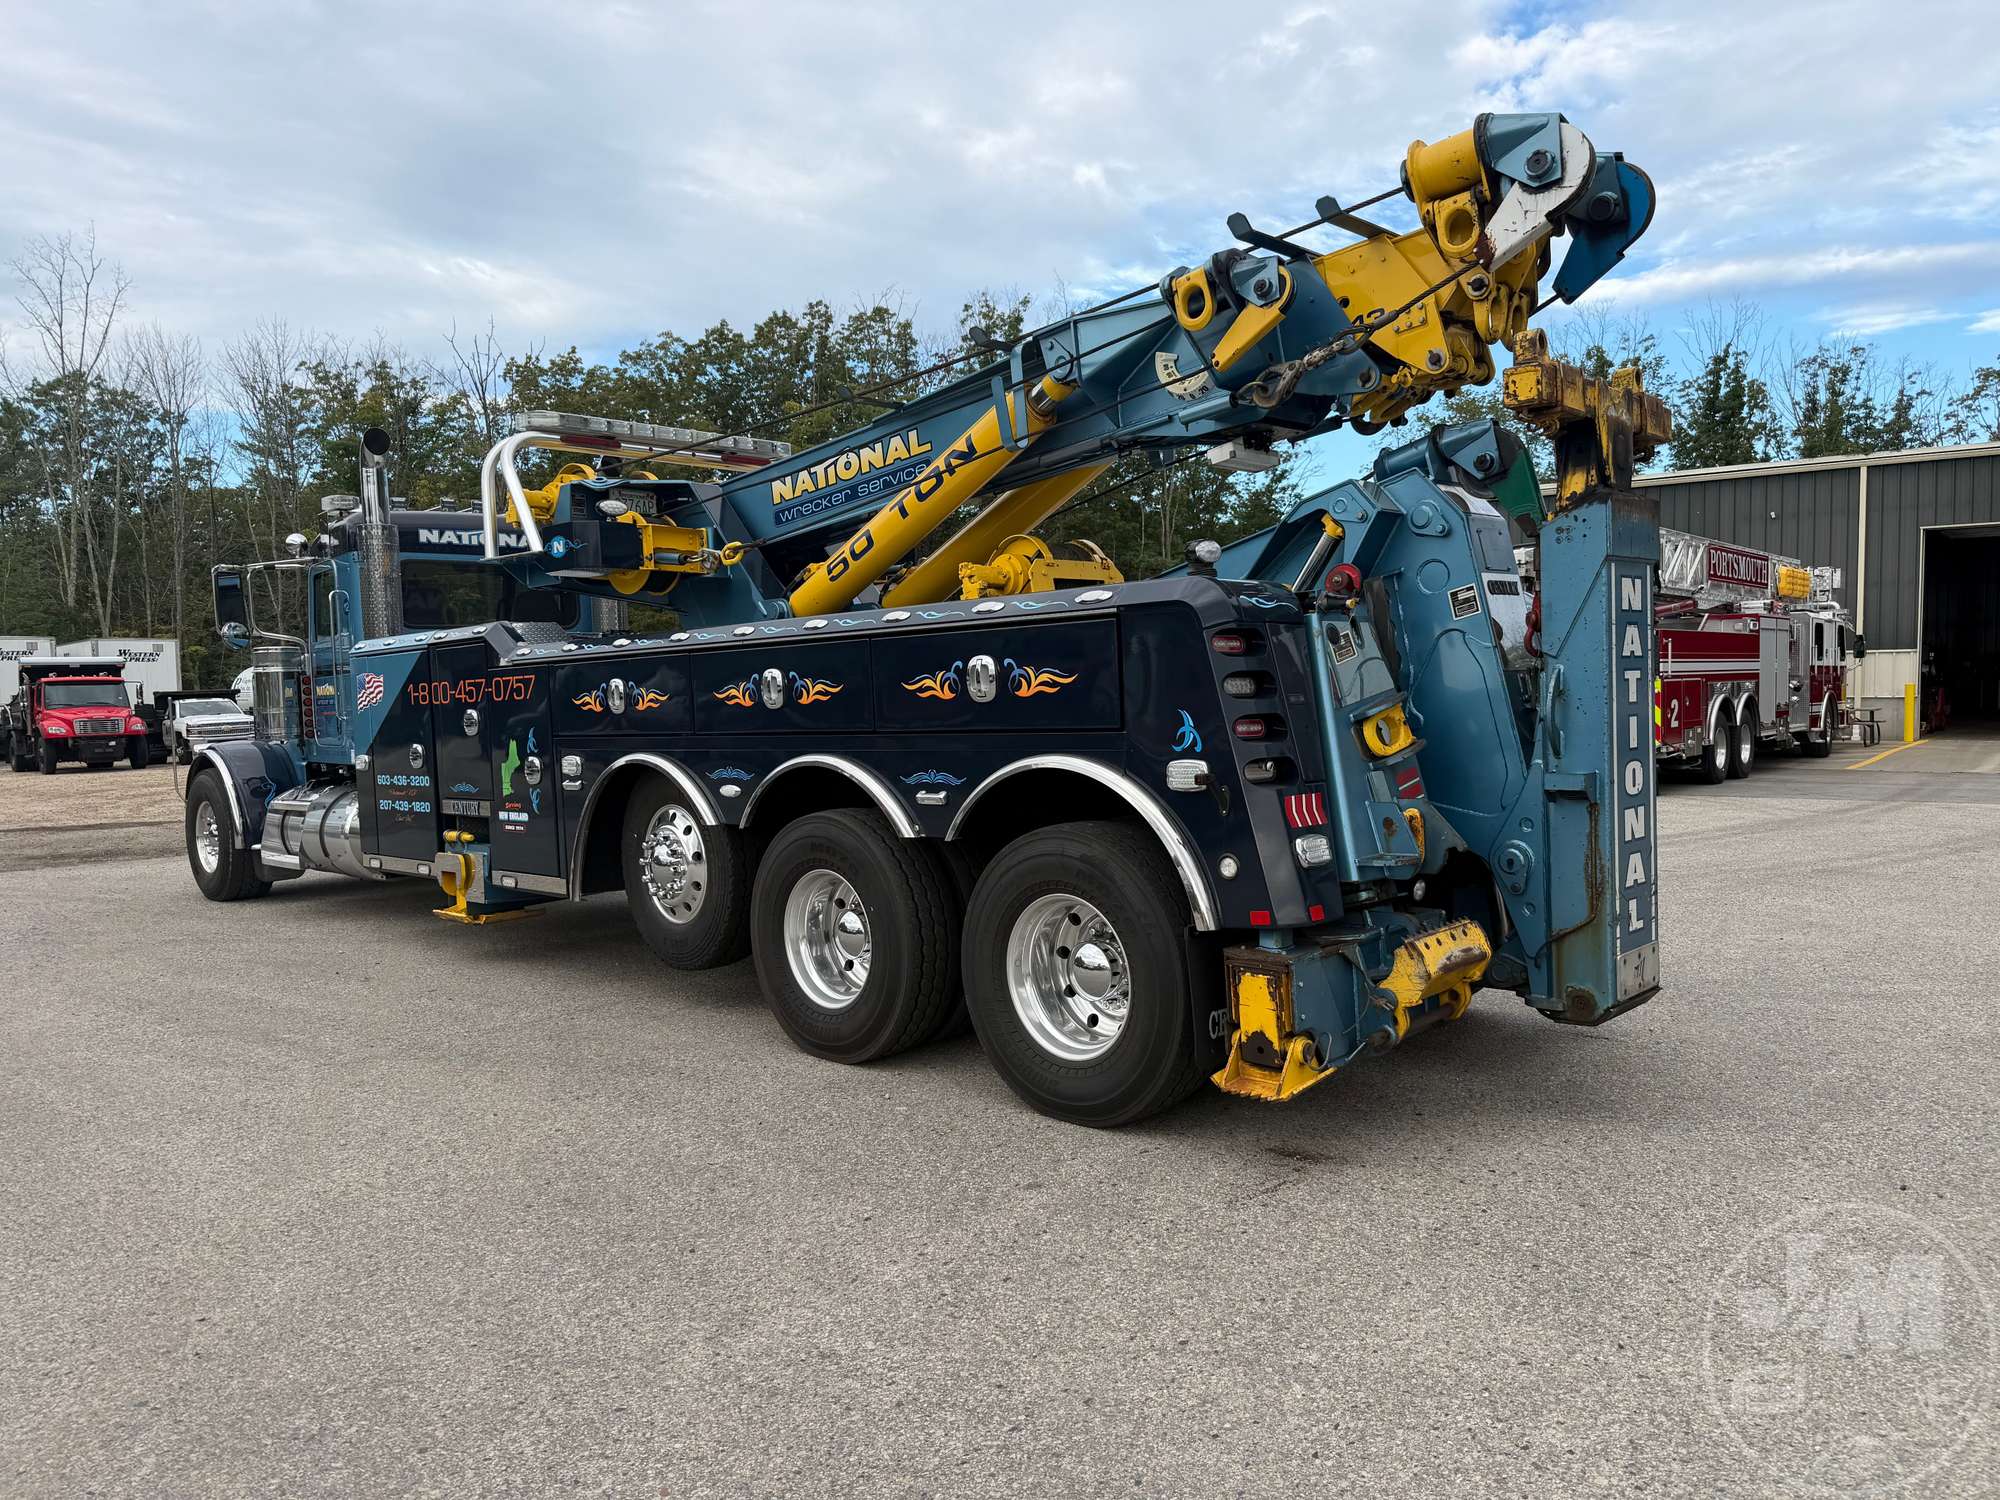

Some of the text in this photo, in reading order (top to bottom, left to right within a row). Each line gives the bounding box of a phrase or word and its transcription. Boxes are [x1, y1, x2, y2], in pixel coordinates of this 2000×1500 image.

[771, 427, 932, 505] NATIONAL
[779, 463, 927, 522] wrecker service
[826, 433, 978, 582] 50 TON
[553, 540, 564, 553] N
[1710, 549, 1768, 584] PORTSMOUTH
[117, 649, 160, 657] WESTERN
[407, 674, 536, 705] 1-800-457-0757
[1670, 698, 1679, 728] 2
[1621, 576, 1646, 933] NATIONAL
[377, 774, 430, 787] 603-436-3200
[379, 799, 431, 813] 207-439-1820
